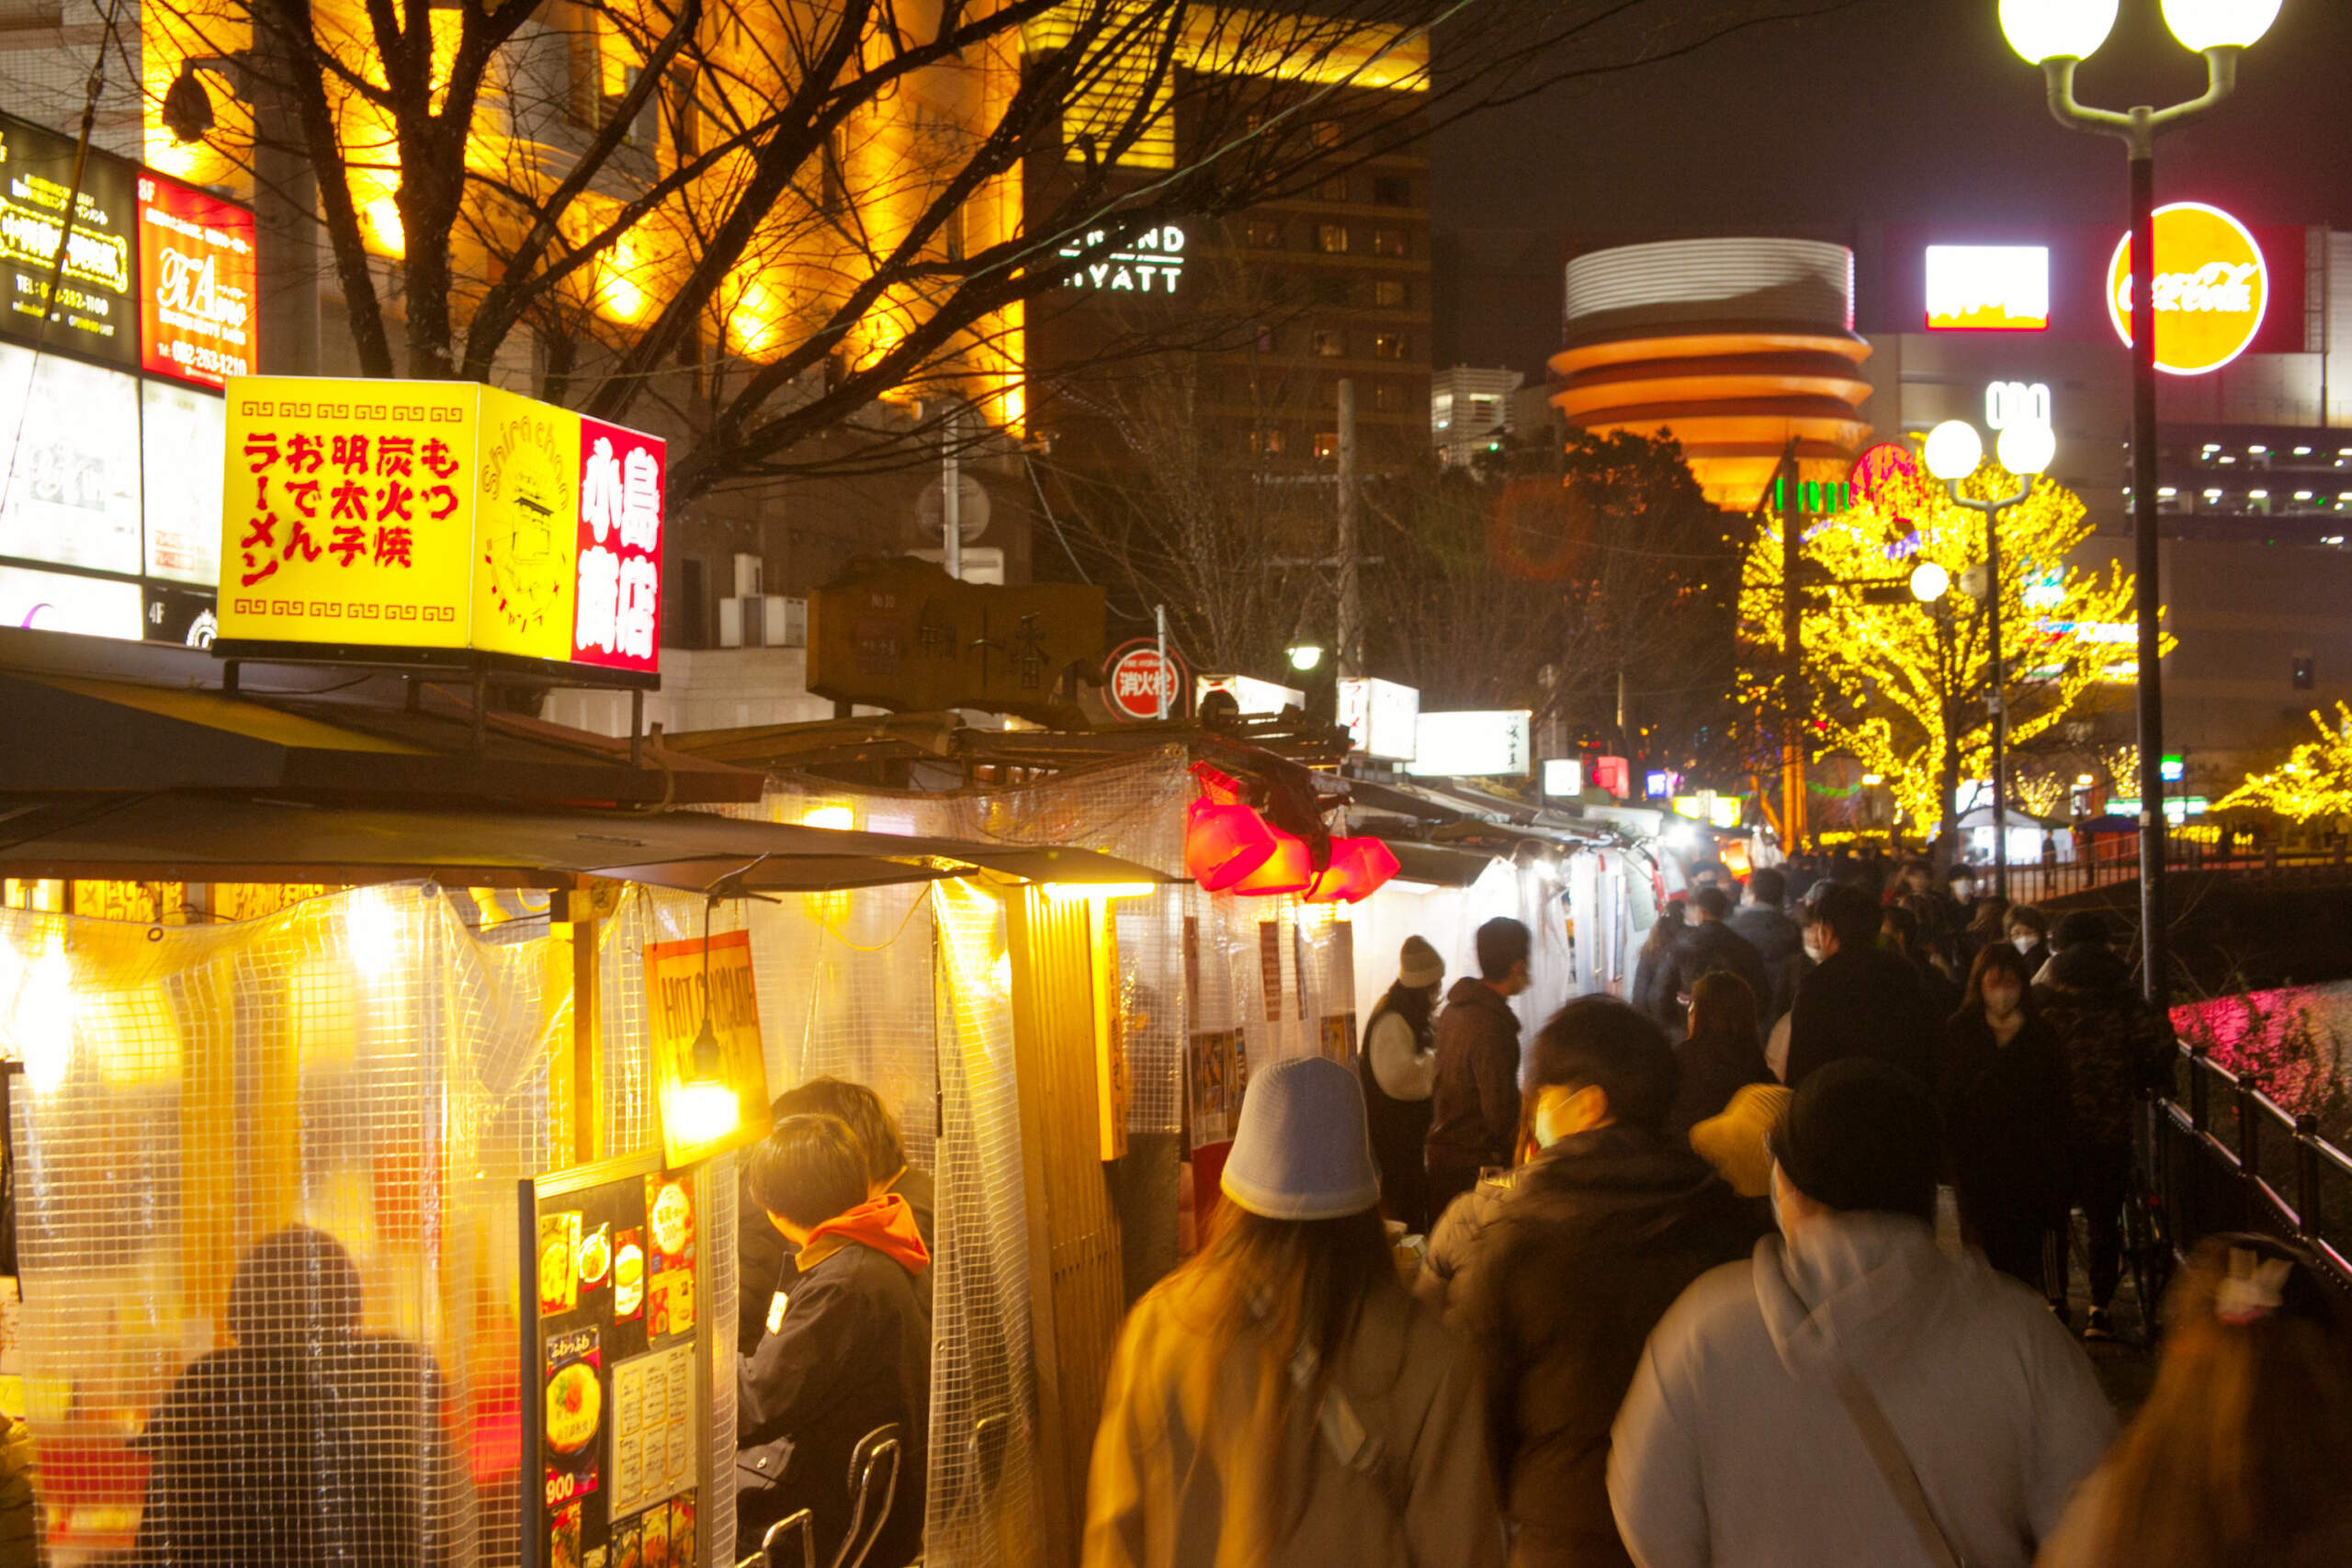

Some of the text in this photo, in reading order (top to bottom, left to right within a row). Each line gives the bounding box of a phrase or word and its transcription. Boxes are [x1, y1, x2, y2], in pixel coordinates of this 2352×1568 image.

[241, 433, 281, 588] ラーメン
[283, 433, 322, 562] おでん
[329, 434, 368, 567] 明太子
[373, 435, 414, 569] 炭火焼
[421, 437, 459, 520] もつ
[545, 1472, 574, 1505] 900
